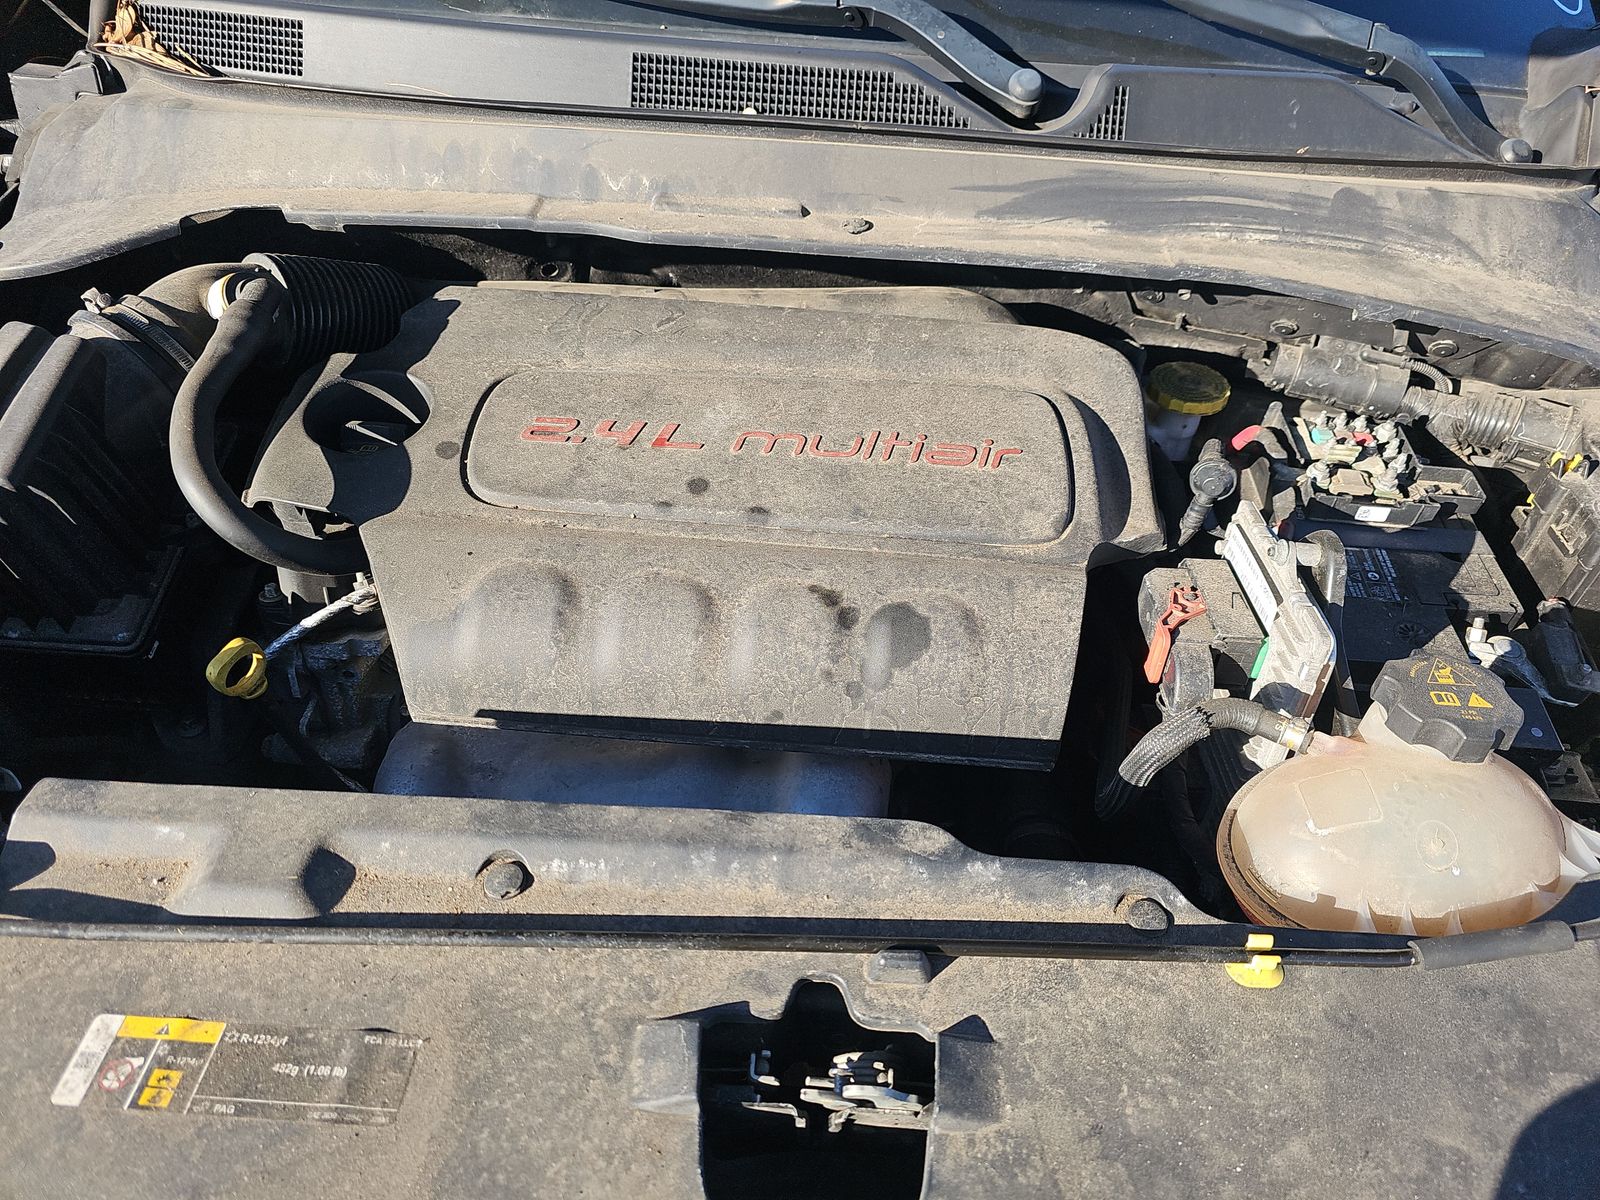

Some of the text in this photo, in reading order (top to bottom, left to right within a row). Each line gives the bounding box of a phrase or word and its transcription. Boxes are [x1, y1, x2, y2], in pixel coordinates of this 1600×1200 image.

[730, 428, 1024, 470] multiair
[364, 1034, 383, 1045] FCA
[304, 1065, 332, 1078] (1.06
[332, 1066, 348, 1079] lb)
[213, 1104, 236, 1114] PAG
